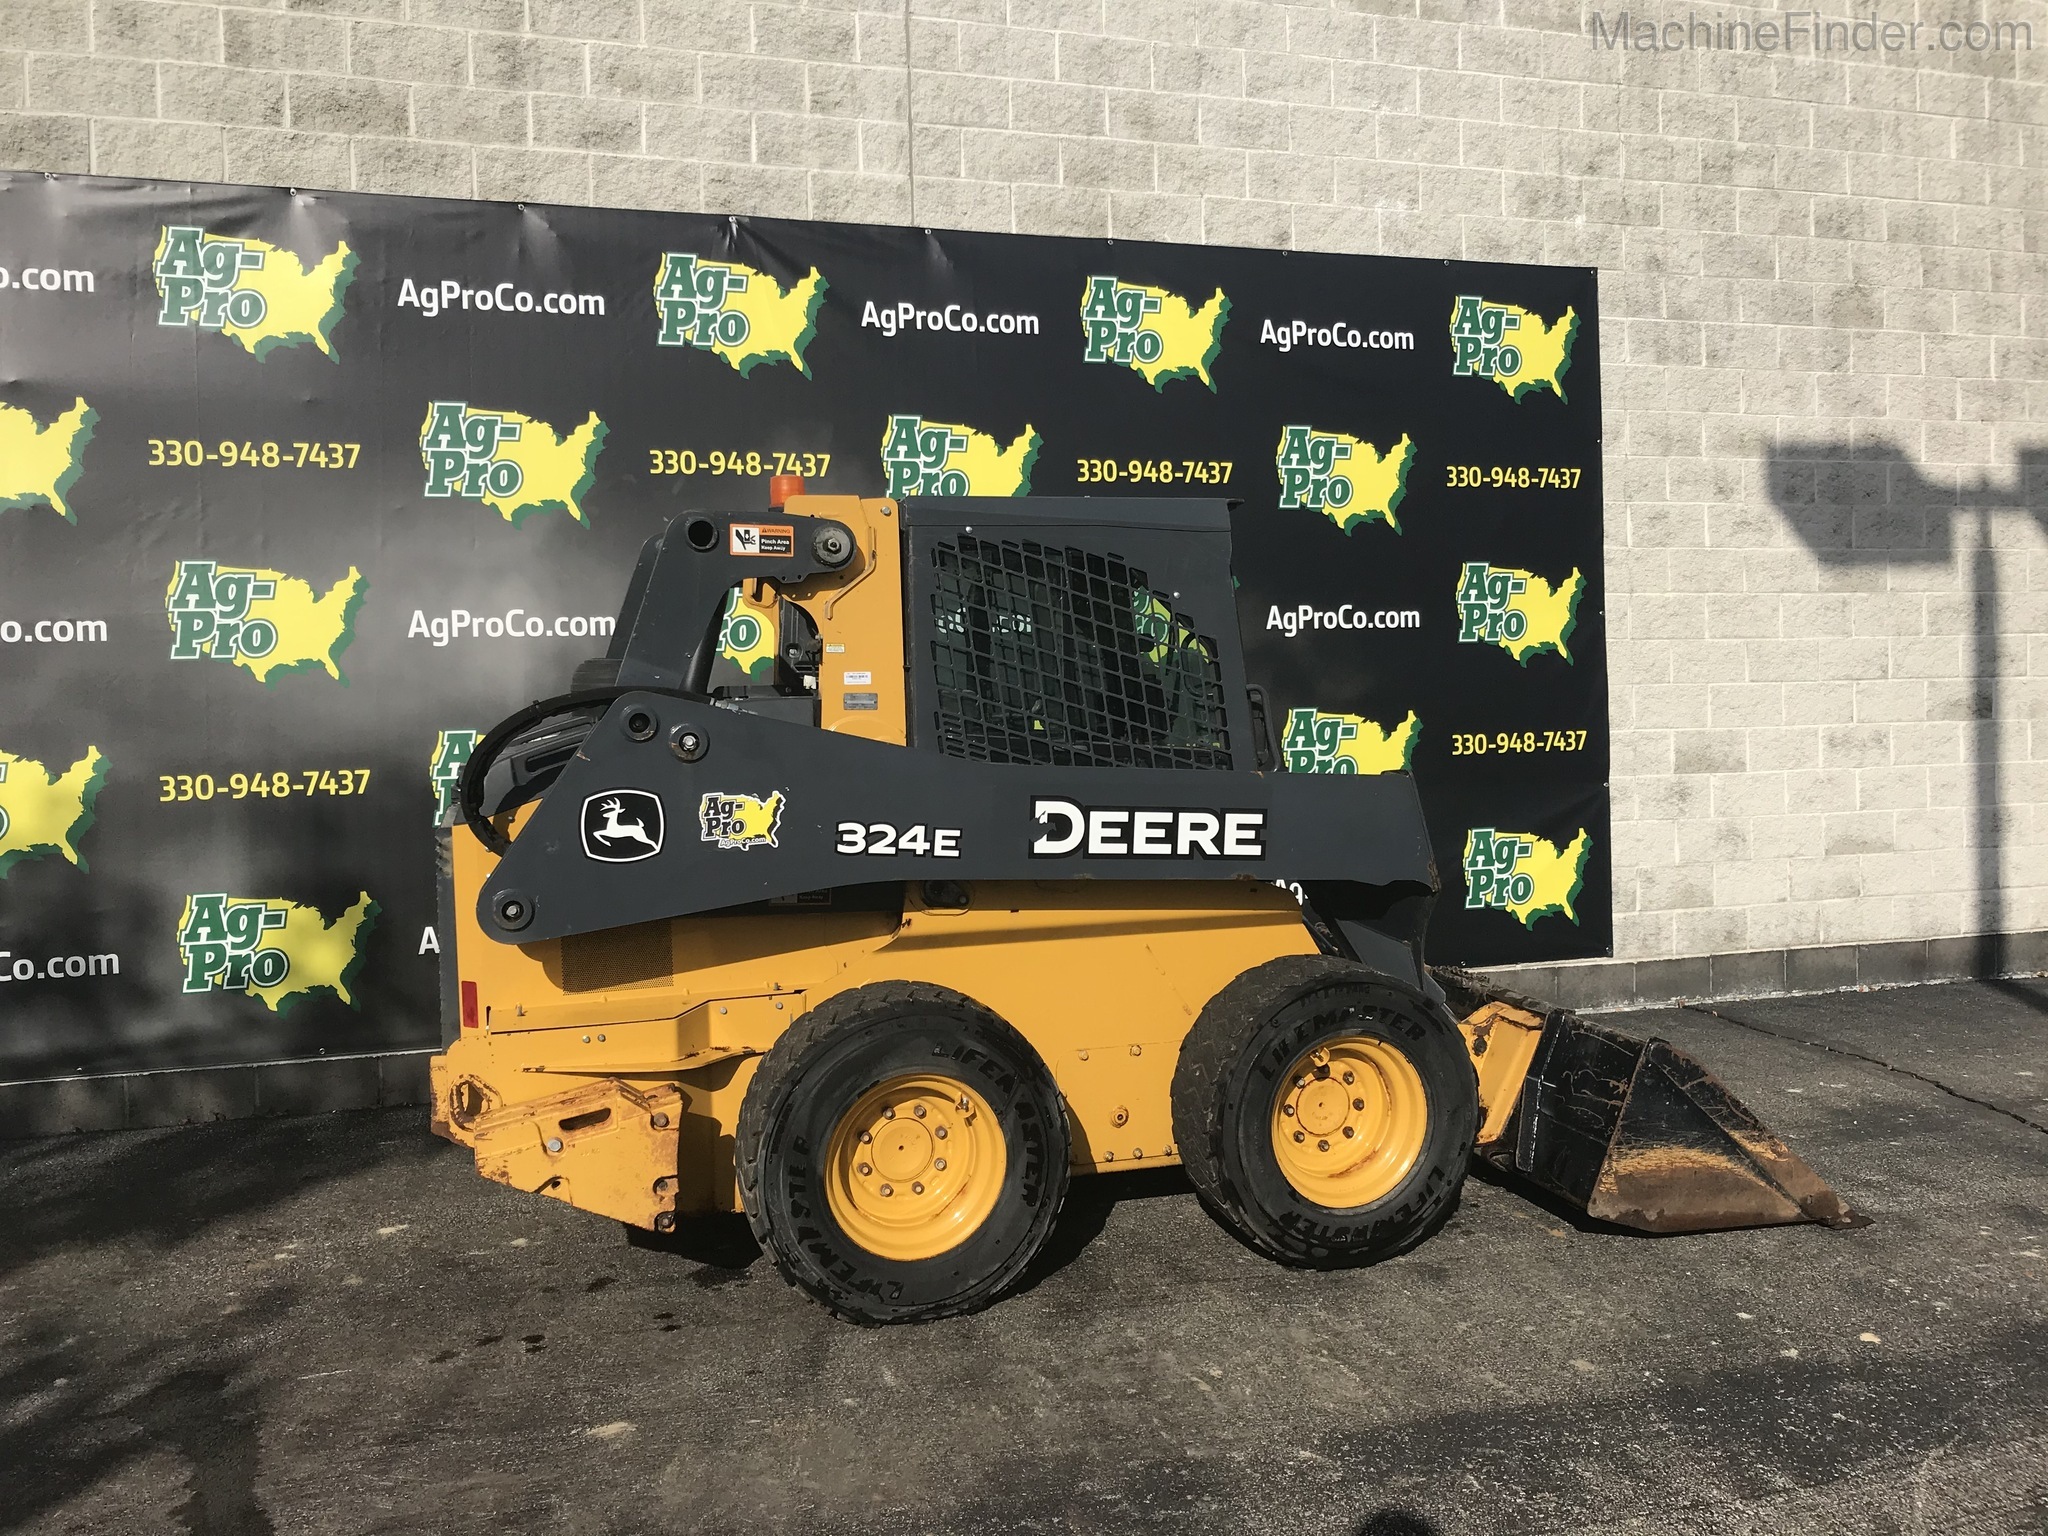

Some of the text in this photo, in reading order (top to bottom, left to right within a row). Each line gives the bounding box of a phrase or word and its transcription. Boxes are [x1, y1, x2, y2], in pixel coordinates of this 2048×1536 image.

[157, 226, 263, 289] Ag-
[158, 277, 266, 328] Pro
[398, 279, 605, 317] AgProCo.com
[659, 253, 747, 312] Ag-
[1085, 276, 1160, 329] Ag-
[658, 302, 749, 347] Pro
[862, 301, 1039, 336] AgProCo.com
[1261, 320, 1414, 352] AgProCo.com
[1455, 296, 1519, 338] Ag-
[1085, 319, 1162, 363] Pro
[1454, 335, 1521, 375] Pro
[424, 402, 520, 459] Ag-
[884, 416, 967, 470] Ag-
[1280, 426, 1351, 472] Ag-
[149, 440, 361, 469] 330-948-7437
[424, 451, 522, 496] Pro
[650, 450, 831, 477] 330-948-7437
[1077, 460, 1233, 484] 330-948-7437
[886, 460, 968, 497] Pro
[1279, 468, 1352, 508] Pro
[1447, 466, 1581, 489] 330-948-7437
[170, 561, 275, 614] Ag-
[1460, 562, 1525, 605] Ag-
[171, 609, 277, 659] Pro
[408, 609, 616, 646] AgProCo.com
[1266, 605, 1420, 637] AgProCo.com
[1459, 602, 1527, 642] Pro
[1284, 709, 1357, 757] Ag-
[1452, 730, 1587, 755] 330-948-7437
[159, 769, 371, 801] 330-948-7437
[703, 795, 745, 820] Ag-
[704, 818, 747, 838] Pro
[1033, 800, 1264, 856] DEERE
[836, 823, 962, 857] 324E
[1468, 828, 1532, 872] Ag-
[1465, 867, 1534, 910] Pro
[181, 893, 286, 948] Ag-
[182, 943, 289, 993] Pro
